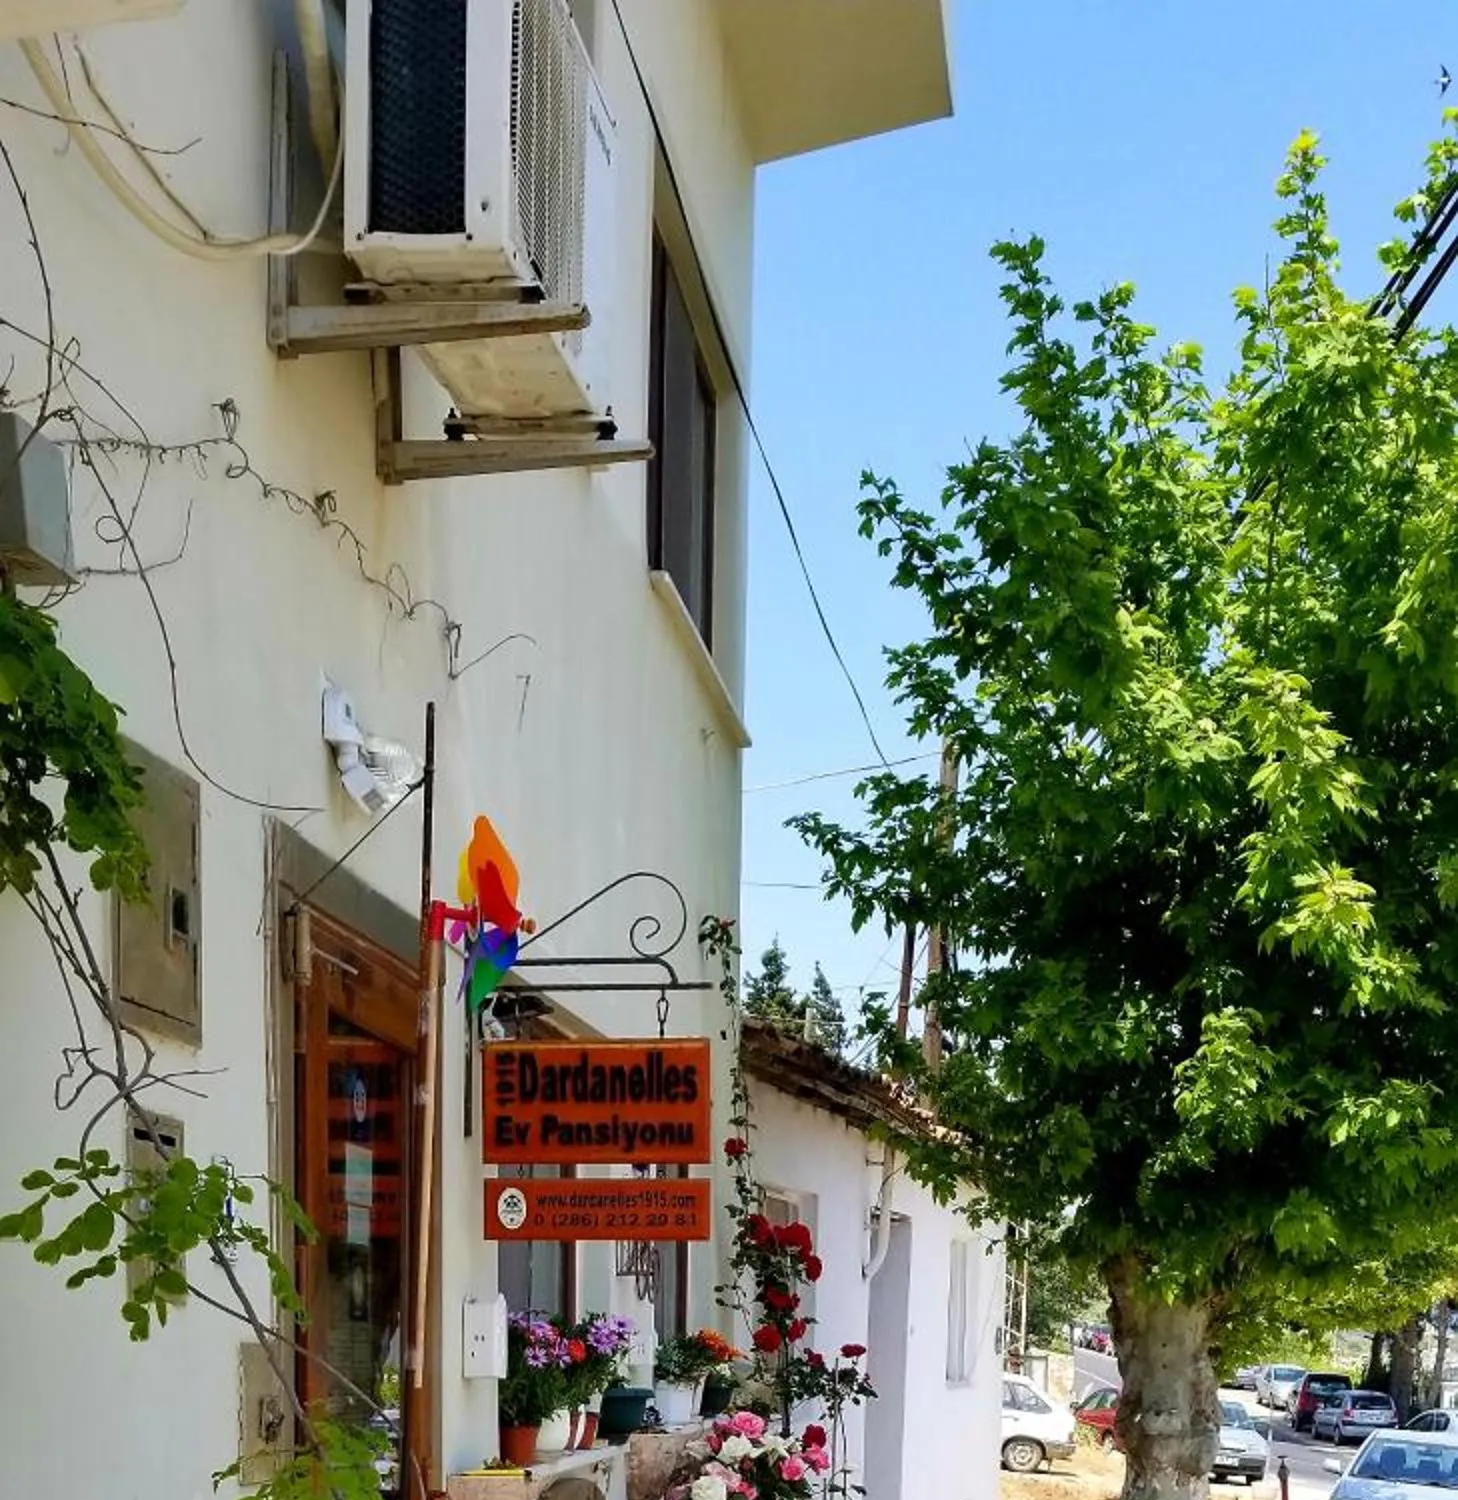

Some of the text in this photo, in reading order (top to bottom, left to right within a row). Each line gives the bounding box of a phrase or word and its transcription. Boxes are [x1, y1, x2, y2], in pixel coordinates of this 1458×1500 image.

[518, 1051, 698, 1104] Dardanelles
[495, 1114, 695, 1153] Ev Pansiyonu
[534, 1213, 545, 1227] 0
[552, 1213, 599, 1228] (286)
[606, 1213, 637, 1228] 212
